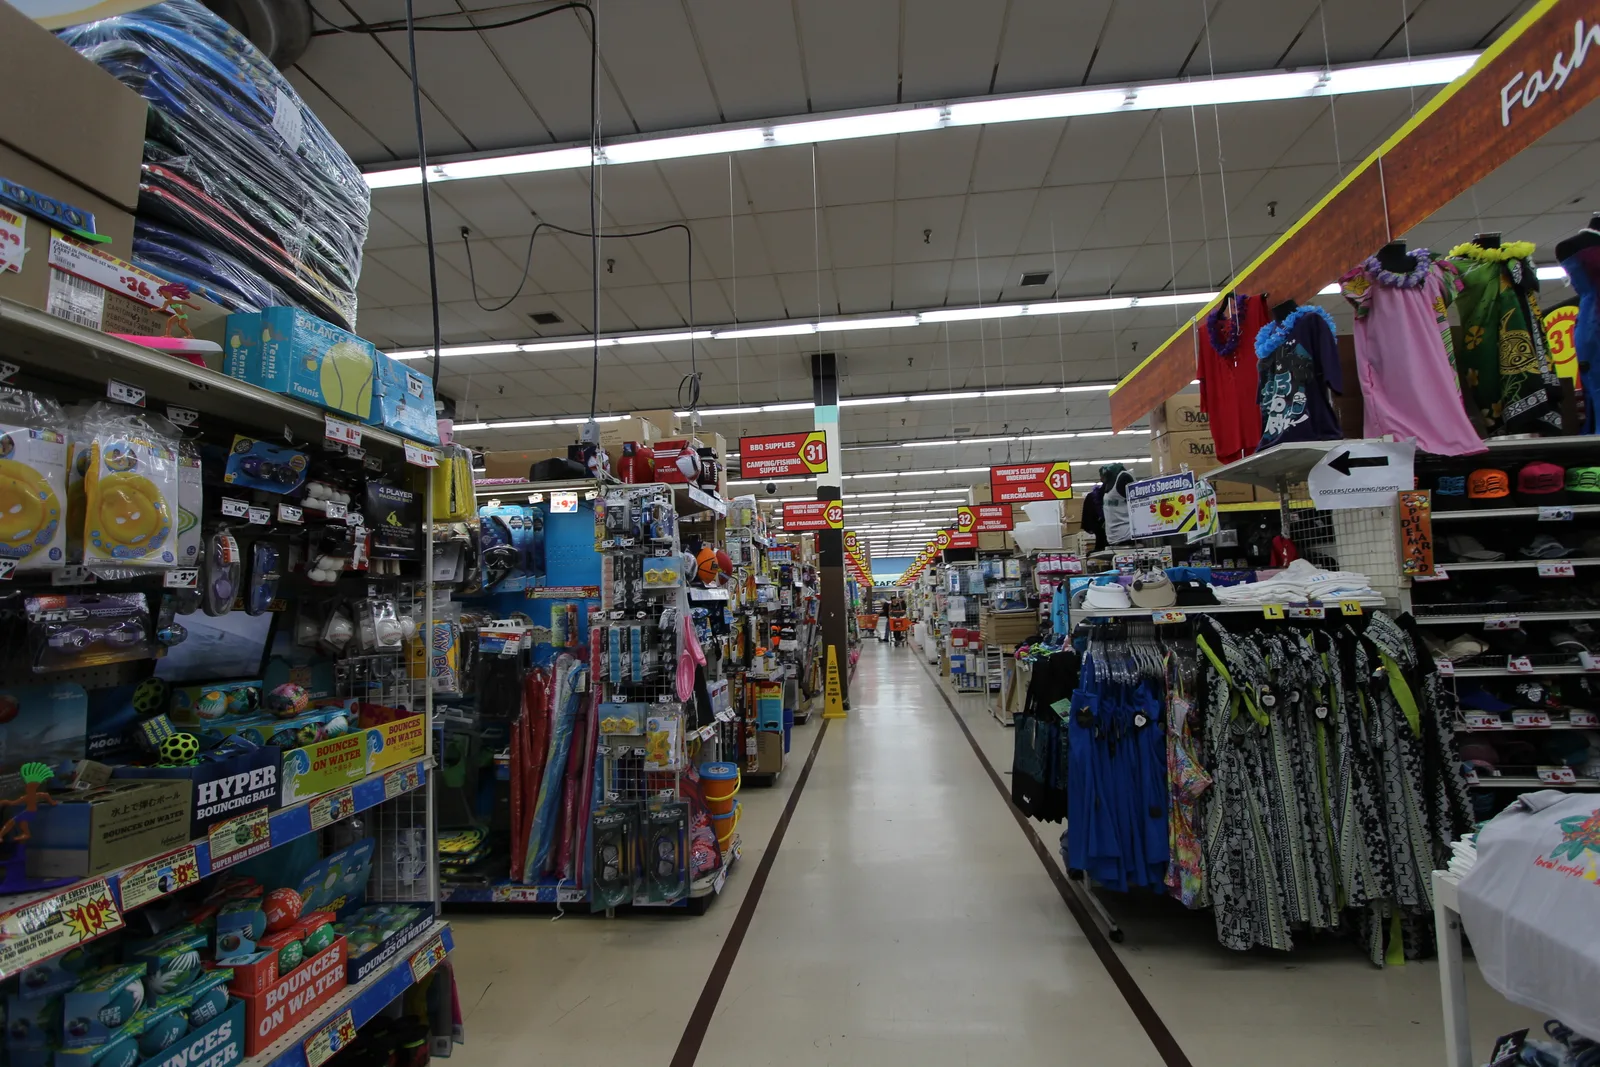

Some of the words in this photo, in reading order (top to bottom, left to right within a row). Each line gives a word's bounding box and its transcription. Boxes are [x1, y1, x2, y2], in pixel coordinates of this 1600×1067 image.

[296, 314, 344, 343] BALANCE
[268, 343, 279, 379] Tennis
[293, 382, 320, 399] Tennis
[750, 443, 764, 451] BBQ
[765, 441, 796, 450] SUPPLIES
[806, 444, 824, 461] 31
[746, 458, 801, 468] CAMPING/FISHING
[759, 466, 789, 474] SUPPLIES
[1052, 474, 1068, 488] 31
[1156, 478, 1182, 492] Special
[386, 488, 413, 499] PLAYER
[1001, 491, 1044, 500] MERCHANDISE
[1319, 485, 1400, 495] COOLERS/CAMPING/SPORTS
[829, 509, 842, 520] 32
[959, 514, 970, 525] 32
[846, 537, 855, 546] 33
[938, 536, 947, 544] 33
[1270, 608, 1277, 616] L
[1345, 604, 1358, 612] XL
[433, 628, 450, 653] MY
[388, 719, 420, 735] BOUNCES
[89, 737, 121, 750] MOON
[386, 737, 396, 746] ON
[398, 728, 422, 743] WATER
[317, 738, 359, 757] BOUNCES
[313, 759, 326, 771] ON
[329, 750, 361, 766] WATER
[198, 765, 277, 806] HYPER
[197, 794, 252, 821] BOUNCING
[252, 787, 276, 806] BALL
[103, 820, 143, 840] BOUNCES
[144, 817, 155, 828] ON
[156, 810, 184, 825] WATER
[212, 857, 232, 871] SUPER
[233, 849, 248, 862] HIGH
[248, 841, 271, 855] BOUNCE
[69, 879, 105, 899] EVERYTIME!
[4, 950, 17, 961] AND
[38, 937, 53, 948] THEM
[13, 938, 30, 949] THEM
[30, 932, 44, 942] INTO
[357, 946, 396, 979] BOUNCES
[396, 936, 407, 950] ON
[408, 914, 434, 941] WATER!
[266, 945, 340, 1011] BOUNCES
[259, 1007, 285, 1036] ON
[288, 964, 345, 1015] WATER
